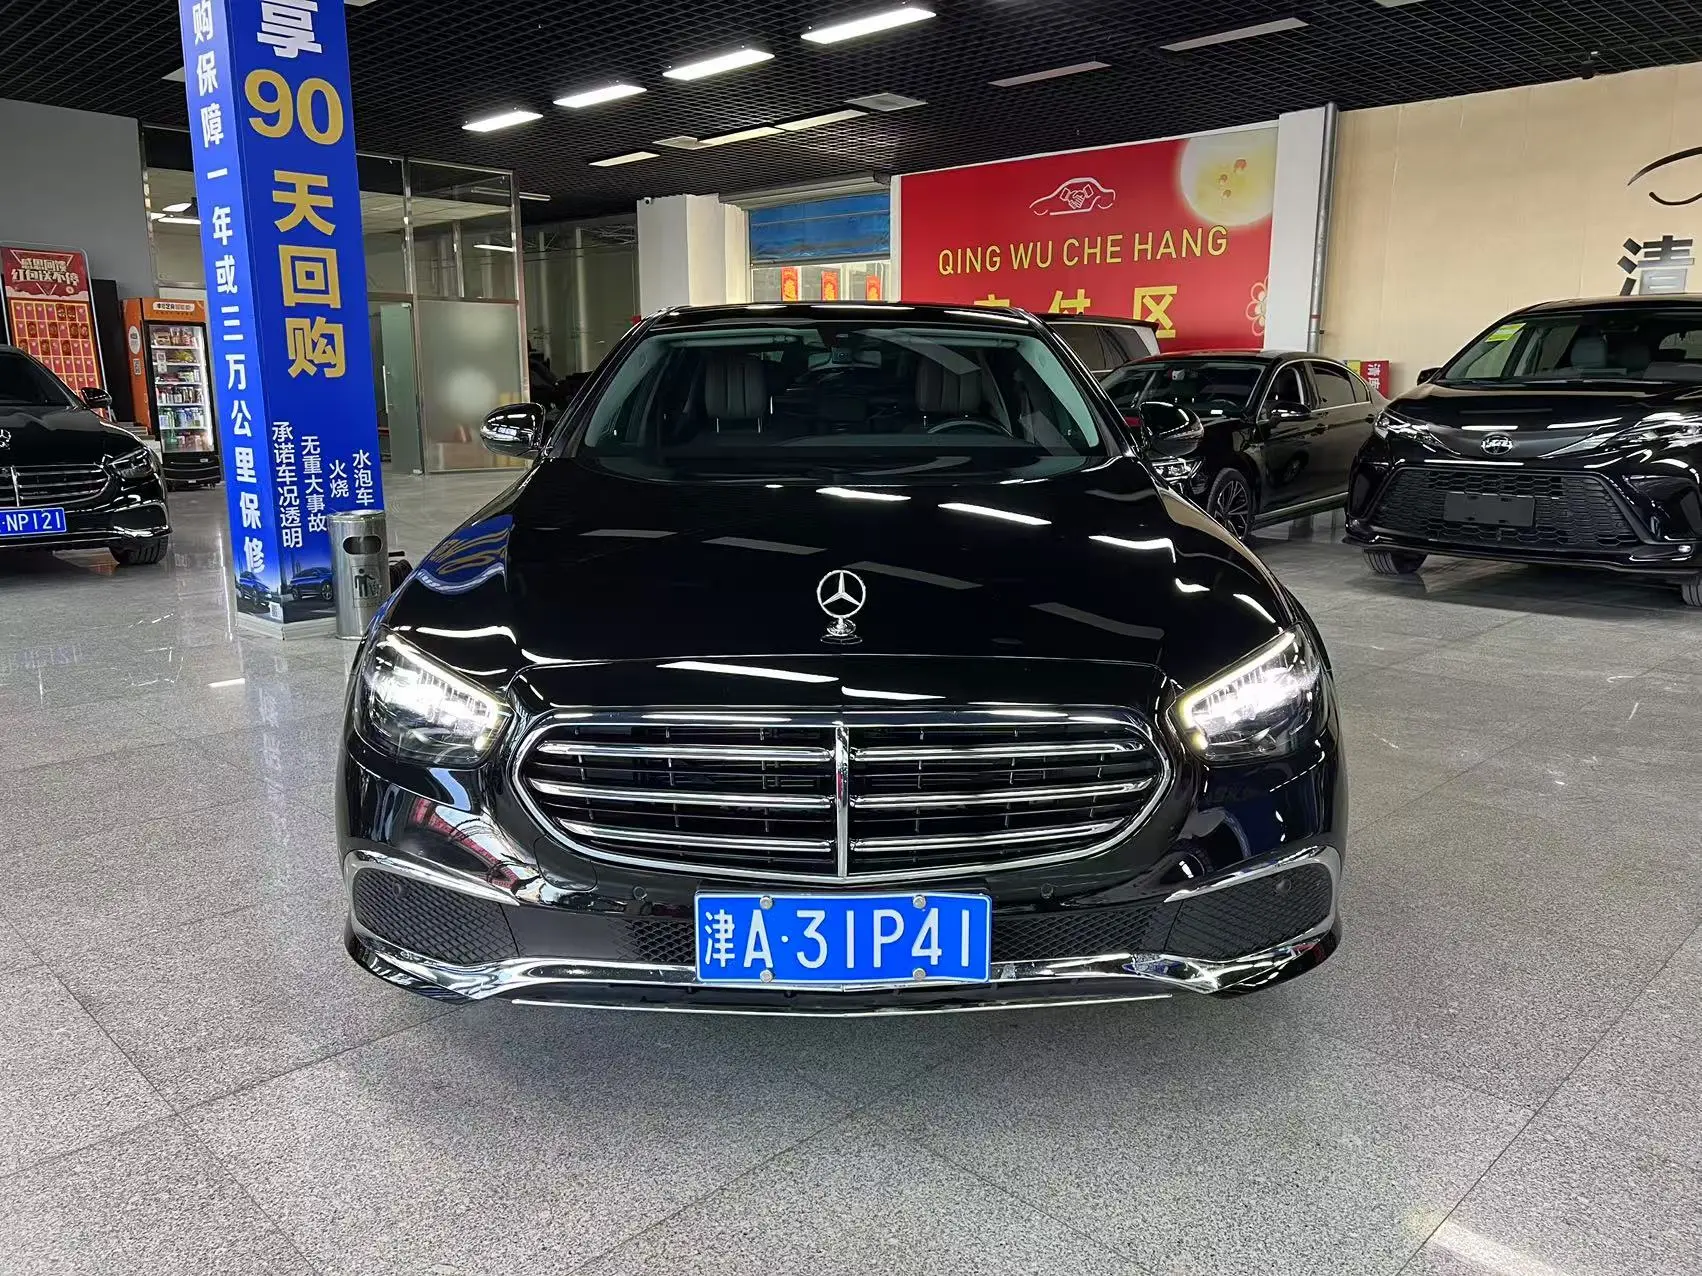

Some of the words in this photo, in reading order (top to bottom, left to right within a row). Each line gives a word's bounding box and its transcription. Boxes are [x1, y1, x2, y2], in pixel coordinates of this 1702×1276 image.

[938, 248, 1001, 275] QING
[1010, 240, 1053, 270] WU
[1062, 234, 1123, 266] CHE
[1133, 225, 1228, 262] HANG
[272, 421, 303, 549] 承诺车况透明
[301, 435, 328, 533] 无重大事故
[329, 459, 349, 499] 火烧
[352, 449, 375, 507] 水泡车
[0, 511, 61, 532] ·NP121
[704, 907, 970, 969] 津A·31P41
